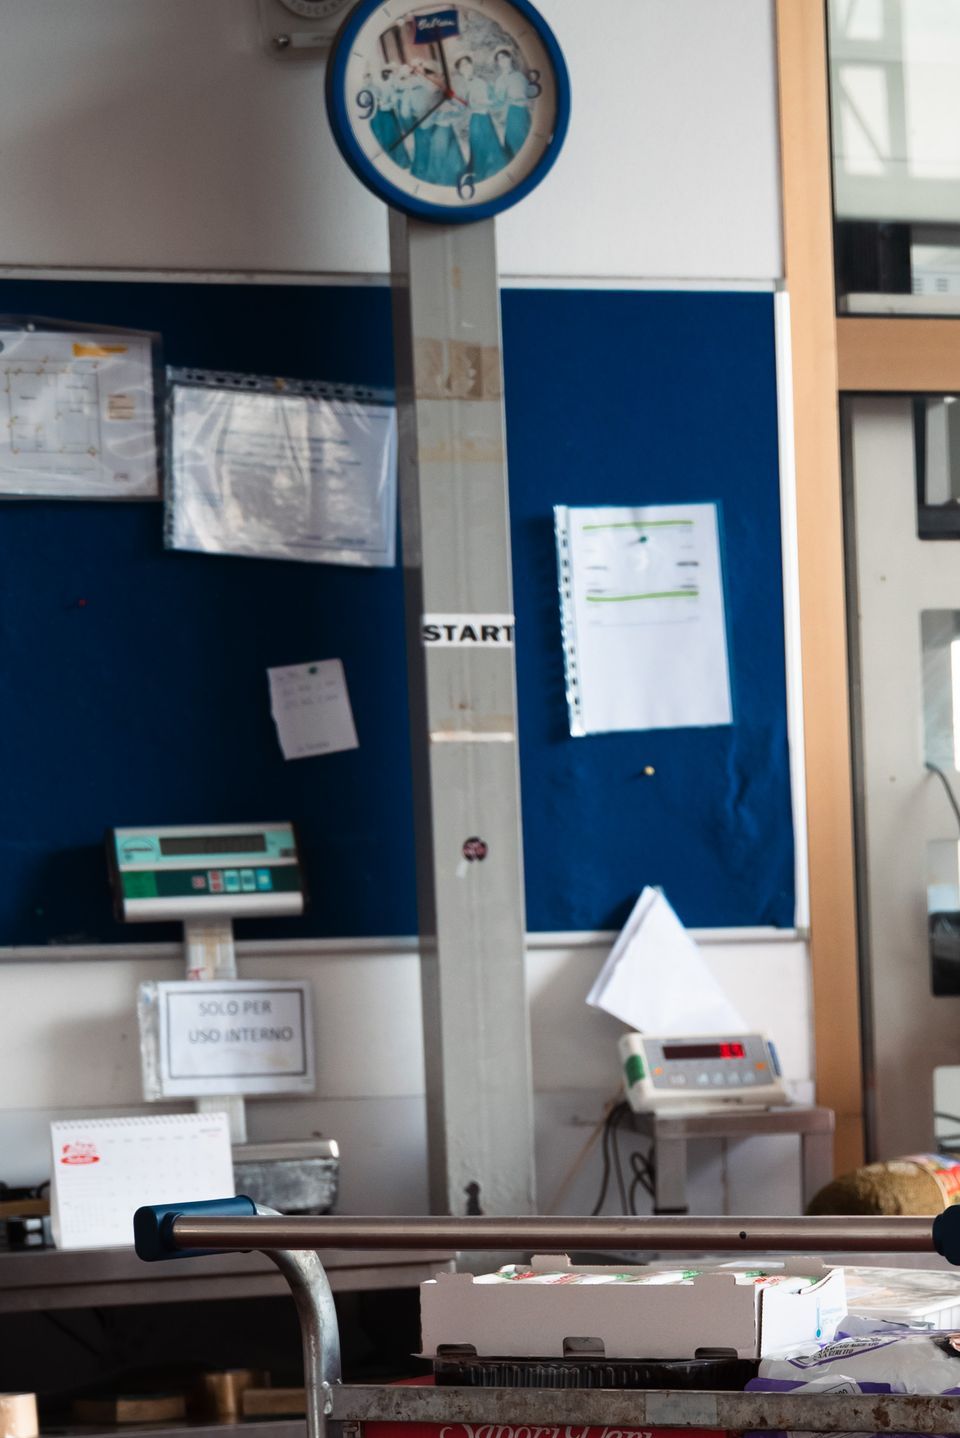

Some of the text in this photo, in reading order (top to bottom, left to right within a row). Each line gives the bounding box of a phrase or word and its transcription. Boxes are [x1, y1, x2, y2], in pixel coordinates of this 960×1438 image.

[356, 89, 375, 119] 9
[456, 172, 476, 201] 6
[423, 624, 515, 642] START
[199, 1000, 272, 1016] SOLO PER
[188, 1026, 294, 1045] USO INTERNO
